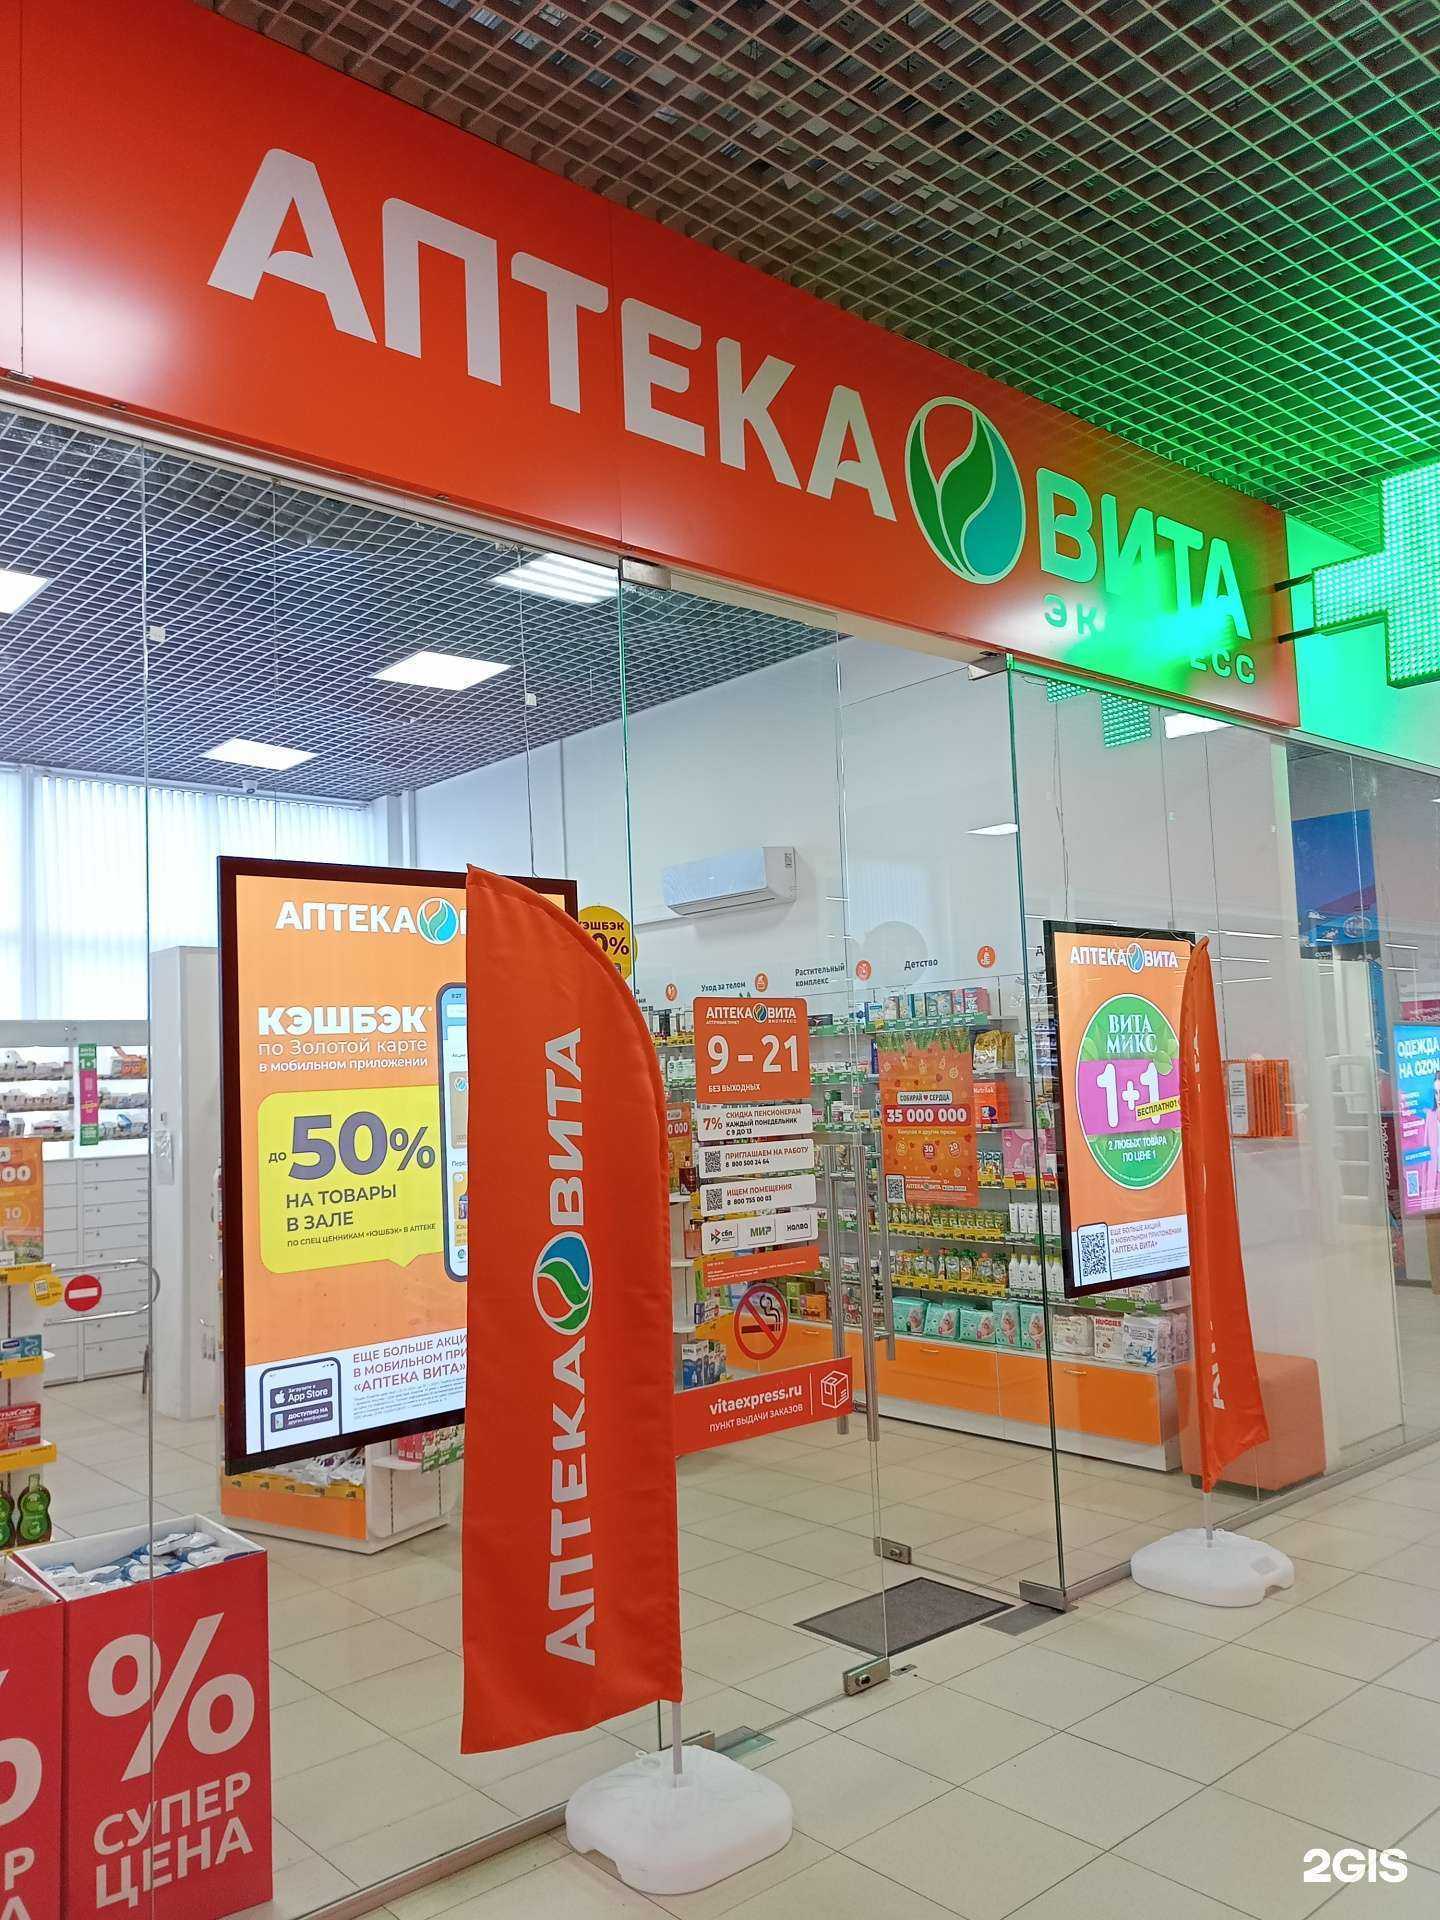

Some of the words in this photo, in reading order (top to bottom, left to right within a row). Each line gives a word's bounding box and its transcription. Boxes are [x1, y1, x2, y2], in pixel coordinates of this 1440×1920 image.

[207, 148, 896, 522] АПТЕКА
[1035, 467, 1252, 640] ВИТА
[275, 901, 417, 934] АПТЕКА
[579, 921, 625, 931] ЭШБЭК
[904, 957, 938, 971] Детство
[1070, 946, 1127, 966] АПТЕКА
[1144, 950, 1178, 968] ВИТА
[795, 962, 846, 977] Растительный
[701, 984, 717, 992] Уход
[718, 983, 725, 991] за
[726, 981, 746, 990] телом
[795, 977, 829, 988] комплекс
[258, 1006, 428, 1036] КЭШБЭК
[706, 1006, 753, 1019] АПТЕКА
[768, 1007, 797, 1019] ВИТА
[1108, 1013, 1153, 1034] ВИТА
[258, 1043, 284, 1056] по
[290, 1037, 371, 1055] Золотой
[377, 1040, 428, 1055] карте
[1106, 1033, 1158, 1054] МИКС
[1398, 1037, 1440, 1059] ОДЕЖДА
[259, 1064, 267, 1072] в
[271, 1060, 346, 1072] мобильном
[350, 1057, 428, 1071] приложении
[707, 1035, 729, 1075] 9
[760, 1034, 799, 1073] 21
[1399, 1063, 1413, 1079] НА
[708, 1085, 721, 1093] БЕЗ
[721, 1083, 761, 1093] ВЫХОДНЫХ
[1096, 1062, 1161, 1128] 1+1
[725, 1110, 753, 1119] СКИДКА
[753, 1107, 801, 1118] ПЕНСИОНЕРАМ
[906, 1108, 935, 1123] 000
[938, 1107, 967, 1123] 000
[1137, 1100, 1177, 1117] БЕСПЛАТНО!
[544, 1027, 584, 1226] ВИТА
[703, 1117, 723, 1131] 7%
[725, 1119, 754, 1129] КАЖДЫЙ
[754, 1117, 798, 1126] ПОНЕДЕЛЬНИК
[288, 1111, 436, 1181] 50%
[725, 1150, 772, 1161] ПРИГЛАШАЕМ
[774, 1149, 783, 1157] НА
[784, 1146, 809, 1156] РАБОТУ
[1108, 1141, 1113, 1151] 2
[1143, 1136, 1167, 1147] ТОВАРА
[1122, 1152, 1134, 1162] ПО
[1134, 1151, 1151, 1162] ЦЕНЕ
[286, 1193, 314, 1209] НА
[318, 1184, 397, 1205] ТОВАРЫ
[726, 1187, 749, 1197] ИЩЕМ
[749, 1183, 793, 1195] ПОМЕЩЕНИЯ
[286, 1217, 299, 1232] В
[304, 1211, 354, 1230] ЗАЛЕ
[750, 1226, 772, 1237] МИР
[287, 1240, 299, 1248] ПО
[300, 1236, 321, 1246] СПЕЦ
[322, 1231, 365, 1244] ЦЕННИКАМ
[409, 1223, 436, 1233] АПТЕКЕ
[1095, 1319, 1121, 1327] HUGGIES
[353, 1350, 380, 1363] ЕЩЕ
[383, 1340, 433, 1358] БОЛЬШЕ
[353, 1367, 361, 1378] В
[364, 1353, 442, 1376] МОБИЛЬНОМ
[353, 1371, 419, 1392] «АПТЕКА
[423, 1362, 466, 1380] ВИТА»
[288, 1393, 305, 1403] App
[306, 1388, 328, 1399] Store
[709, 1385, 803, 1415] vitaexpress.ru
[709, 1419, 735, 1432] ПУНКТ
[736, 1411, 769, 1427] ВЫДАЧИ
[769, 1404, 804, 1419] ЗАКАЗОВ
[546, 1337, 596, 1666] АПТЕКА
[93, 1771, 251, 1856] СУПЕР
[96, 1816, 254, 1909] ЦЕНА
